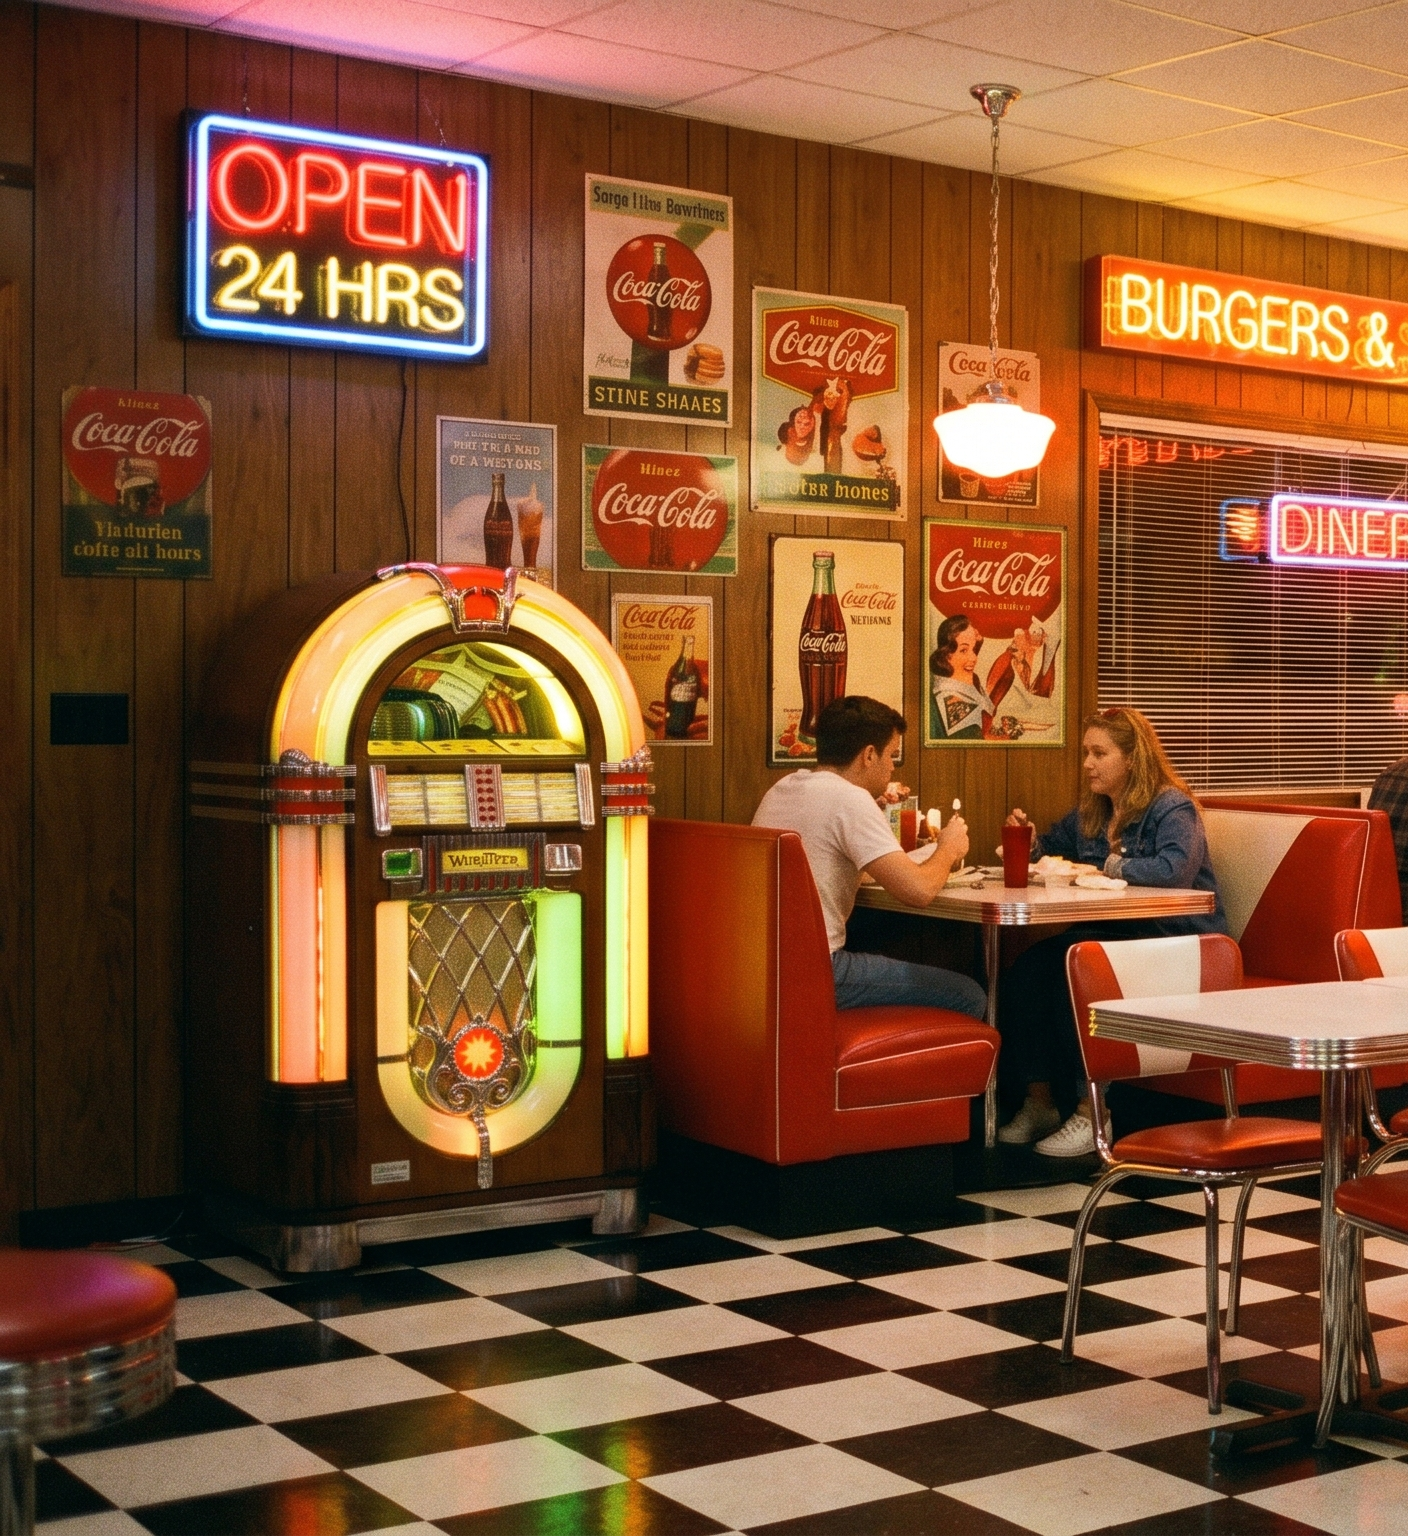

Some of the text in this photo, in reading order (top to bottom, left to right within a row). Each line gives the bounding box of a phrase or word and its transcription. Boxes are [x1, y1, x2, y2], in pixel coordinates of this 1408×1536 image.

[214, 142, 468, 253] OPEN
[215, 245, 467, 333] 24 HRS
[1117, 272, 1351, 364] BURGERS
[1364, 310, 1397, 370] &
